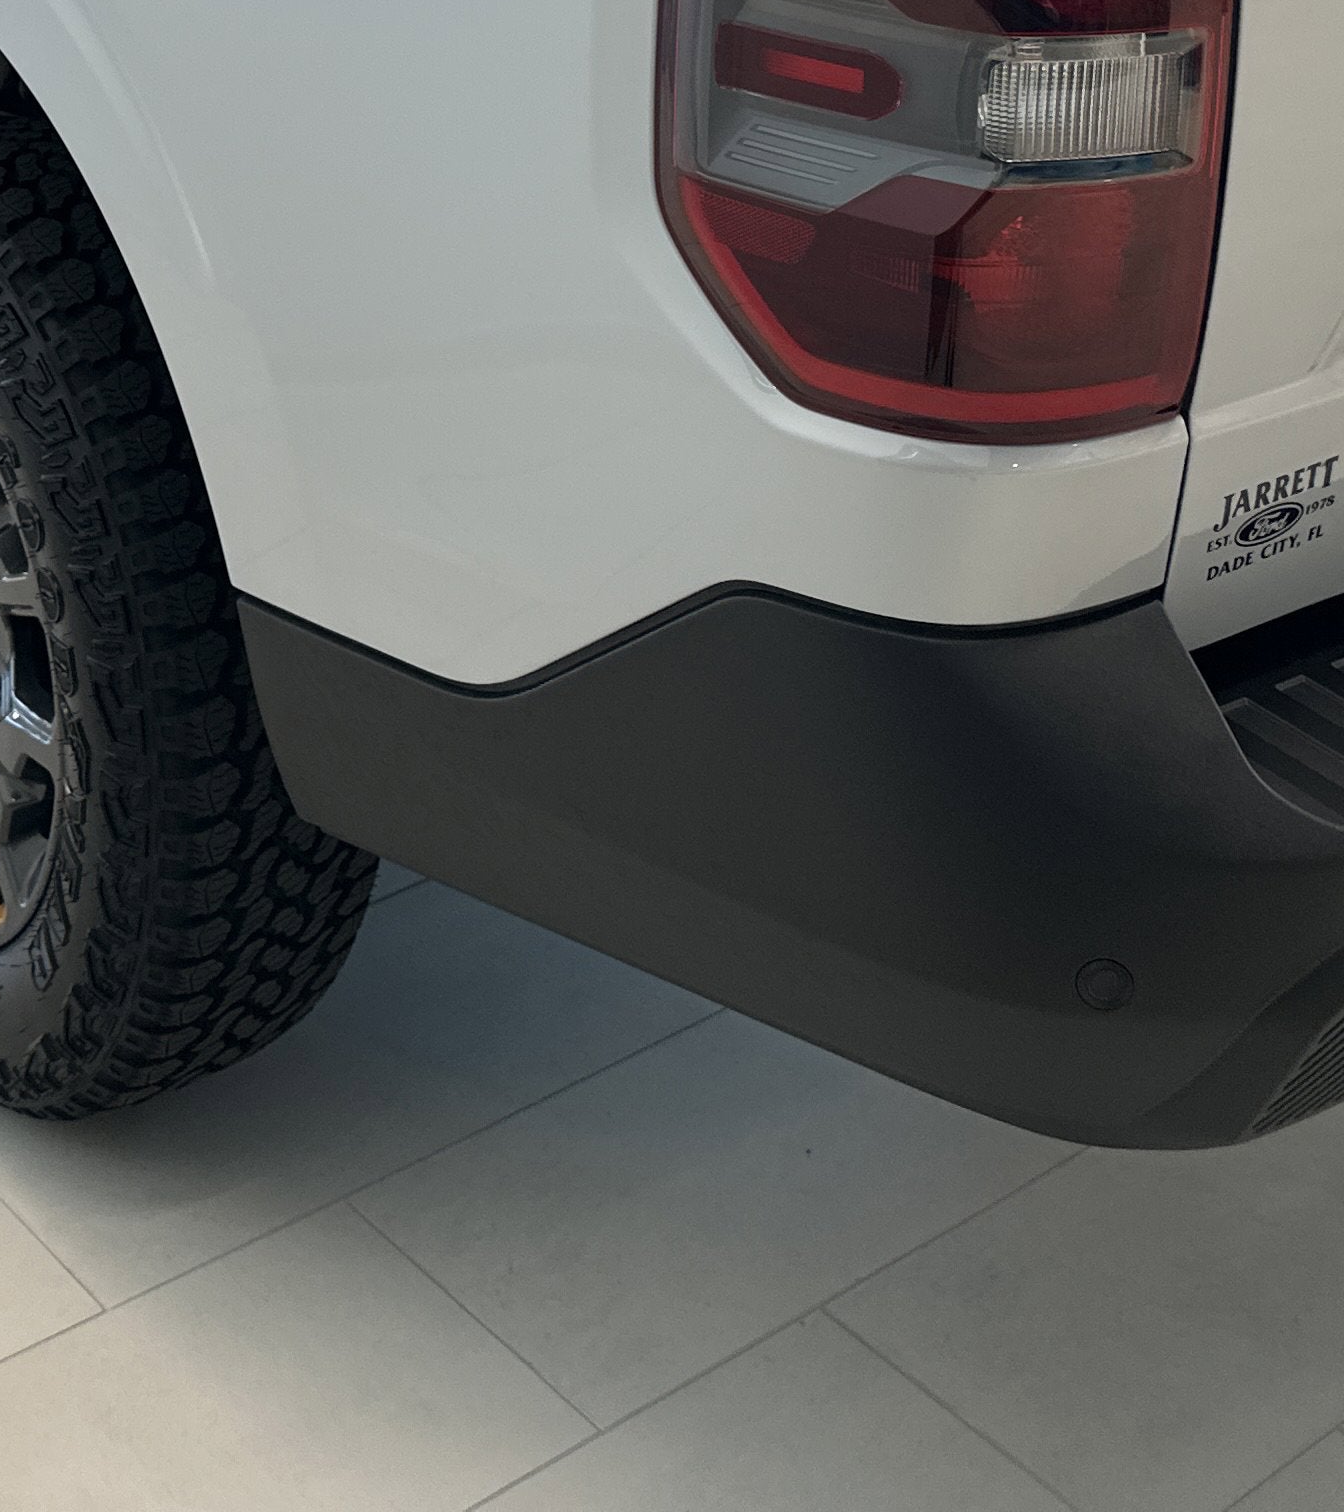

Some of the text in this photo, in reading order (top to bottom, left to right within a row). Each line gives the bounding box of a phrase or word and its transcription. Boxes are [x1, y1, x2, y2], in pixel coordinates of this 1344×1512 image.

[1213, 454, 1340, 533] JARRETT
[1206, 524, 1324, 582] DADE CITY, FL
